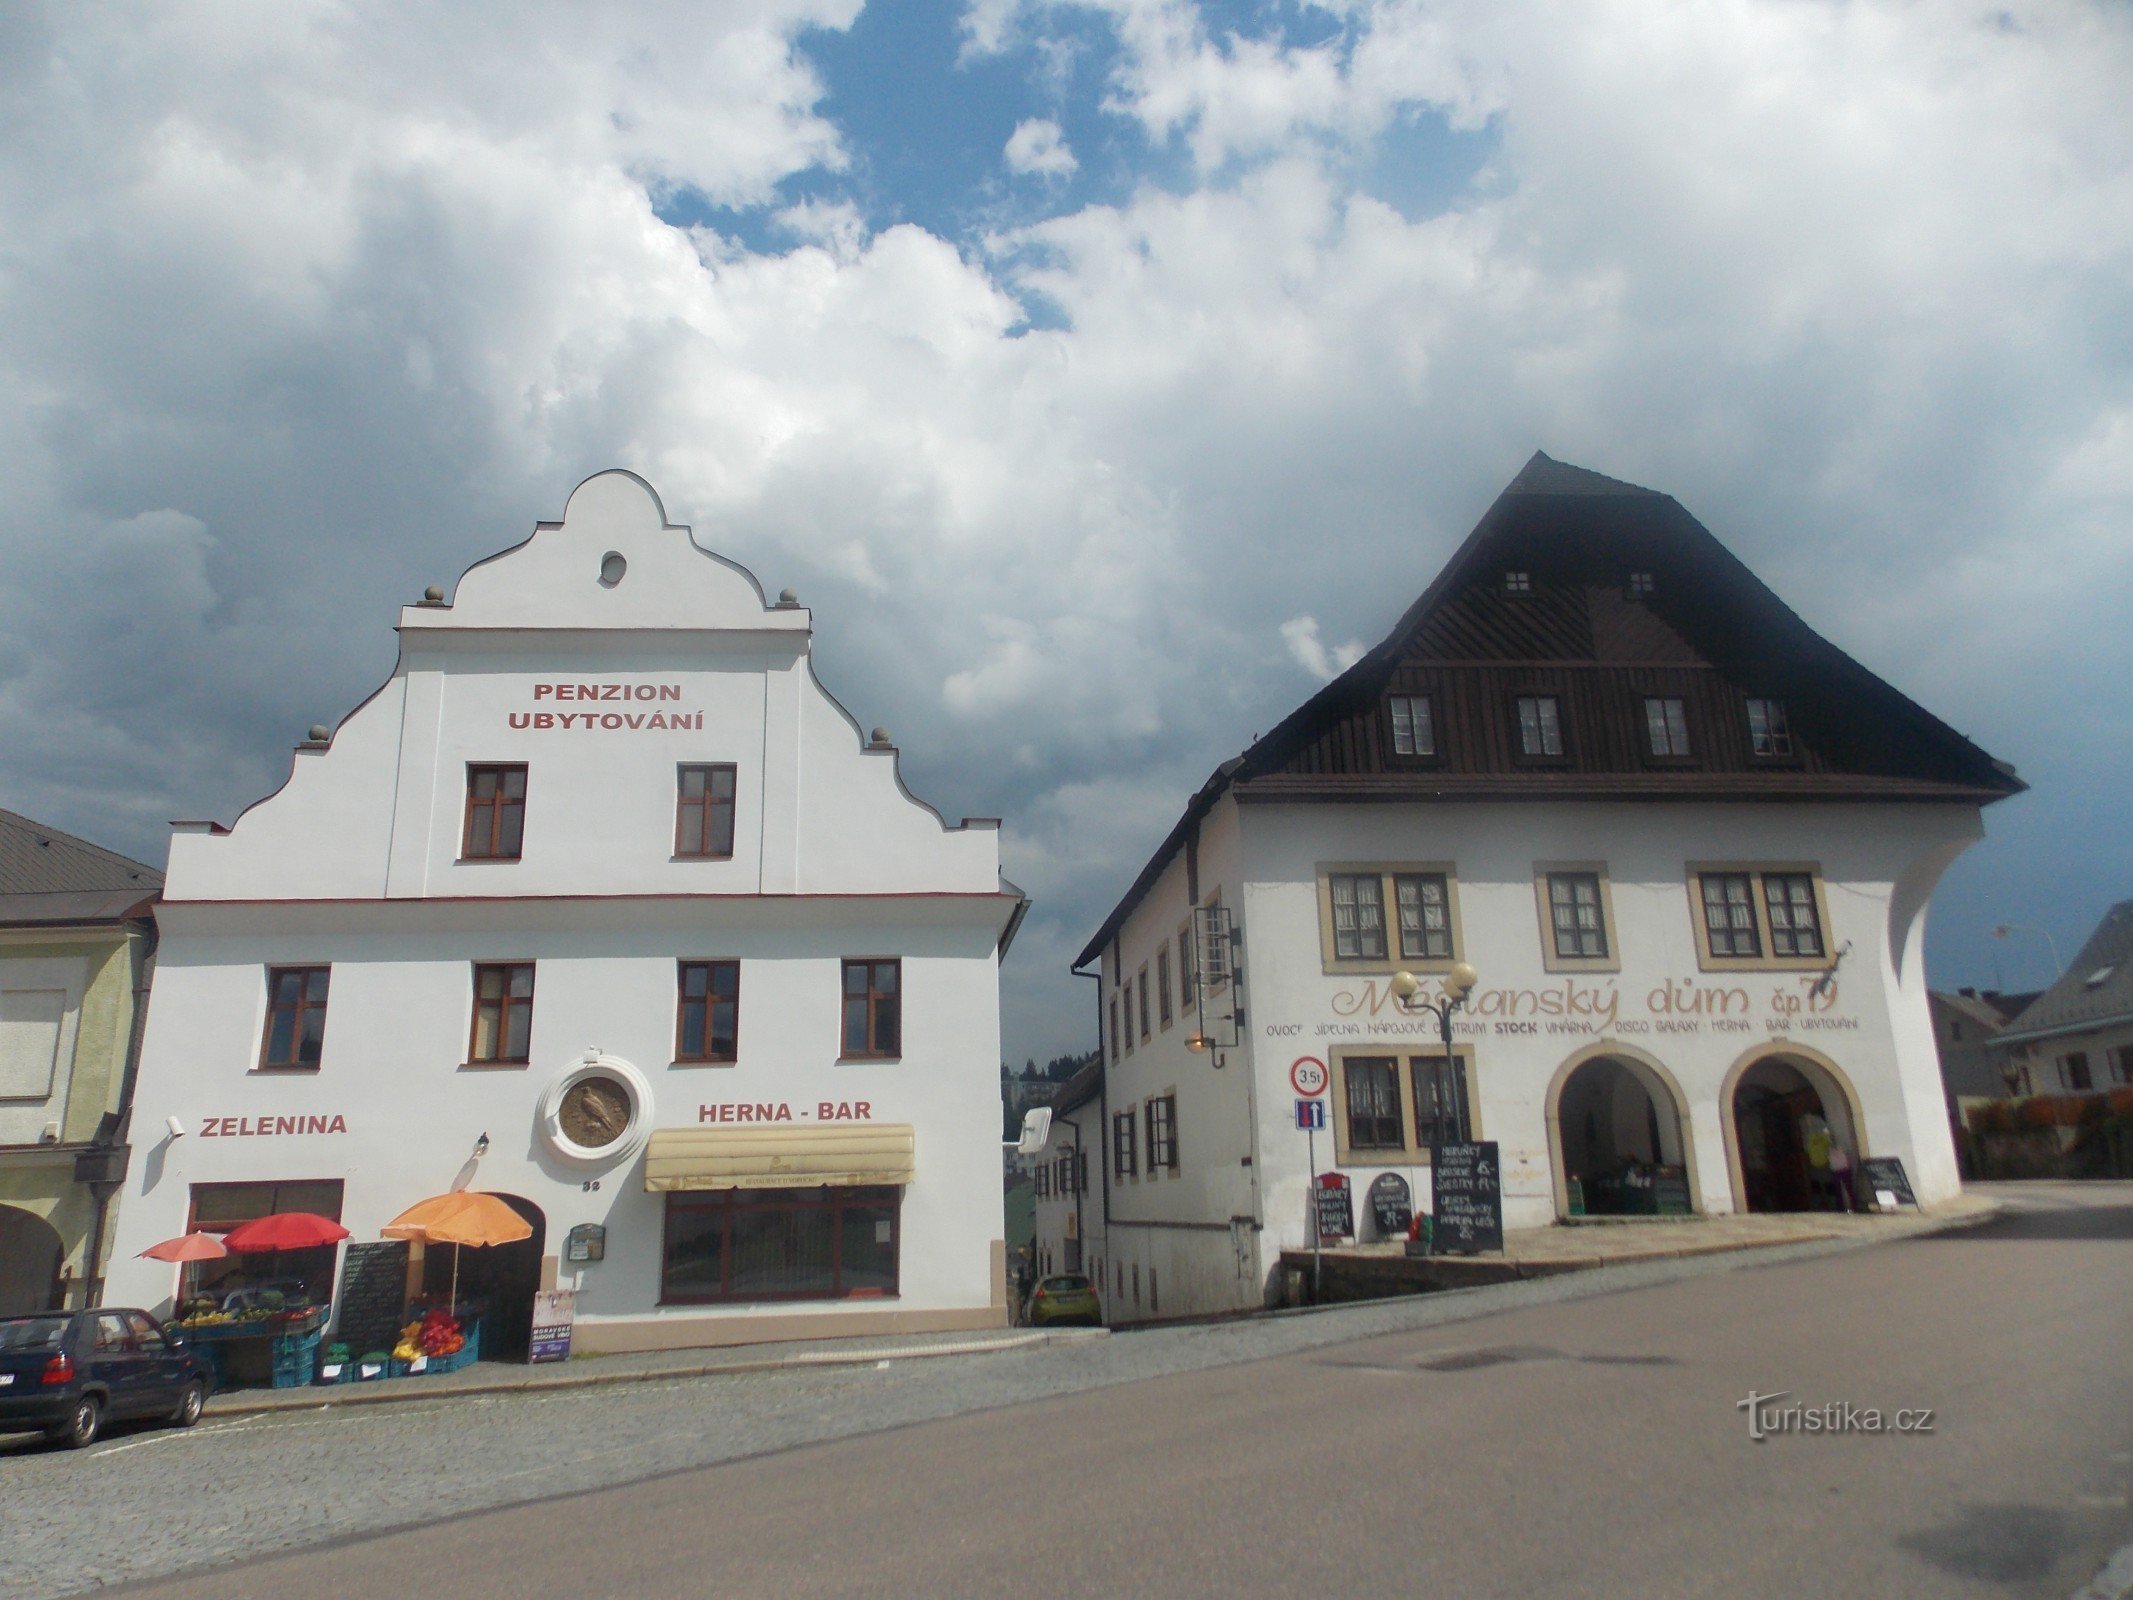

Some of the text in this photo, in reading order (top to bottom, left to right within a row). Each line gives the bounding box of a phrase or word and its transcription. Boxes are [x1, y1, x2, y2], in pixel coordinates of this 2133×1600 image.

[533, 684, 681, 701] PENZION
[508, 709, 704, 730] UBYTOVÁNÍ
[1646, 977, 1749, 1016] dům
[1367, 1019, 1426, 1034] NÁPOJOVÉ
[1432, 1021, 1487, 1034] CNTRUM
[1494, 1022, 1538, 1034] STOCK
[1545, 1018, 1593, 1034] VINÁRNA
[1615, 1020, 1649, 1033] DISCO
[1655, 1020, 1699, 1033] GALAXY
[1711, 1019, 1750, 1032] HERNA
[1765, 1018, 1791, 1031] BAR
[699, 1104, 793, 1122] HERNA
[818, 1102, 871, 1120] BAR
[200, 1115, 347, 1137] ZELENINA
[583, 1181, 599, 1191] 32
